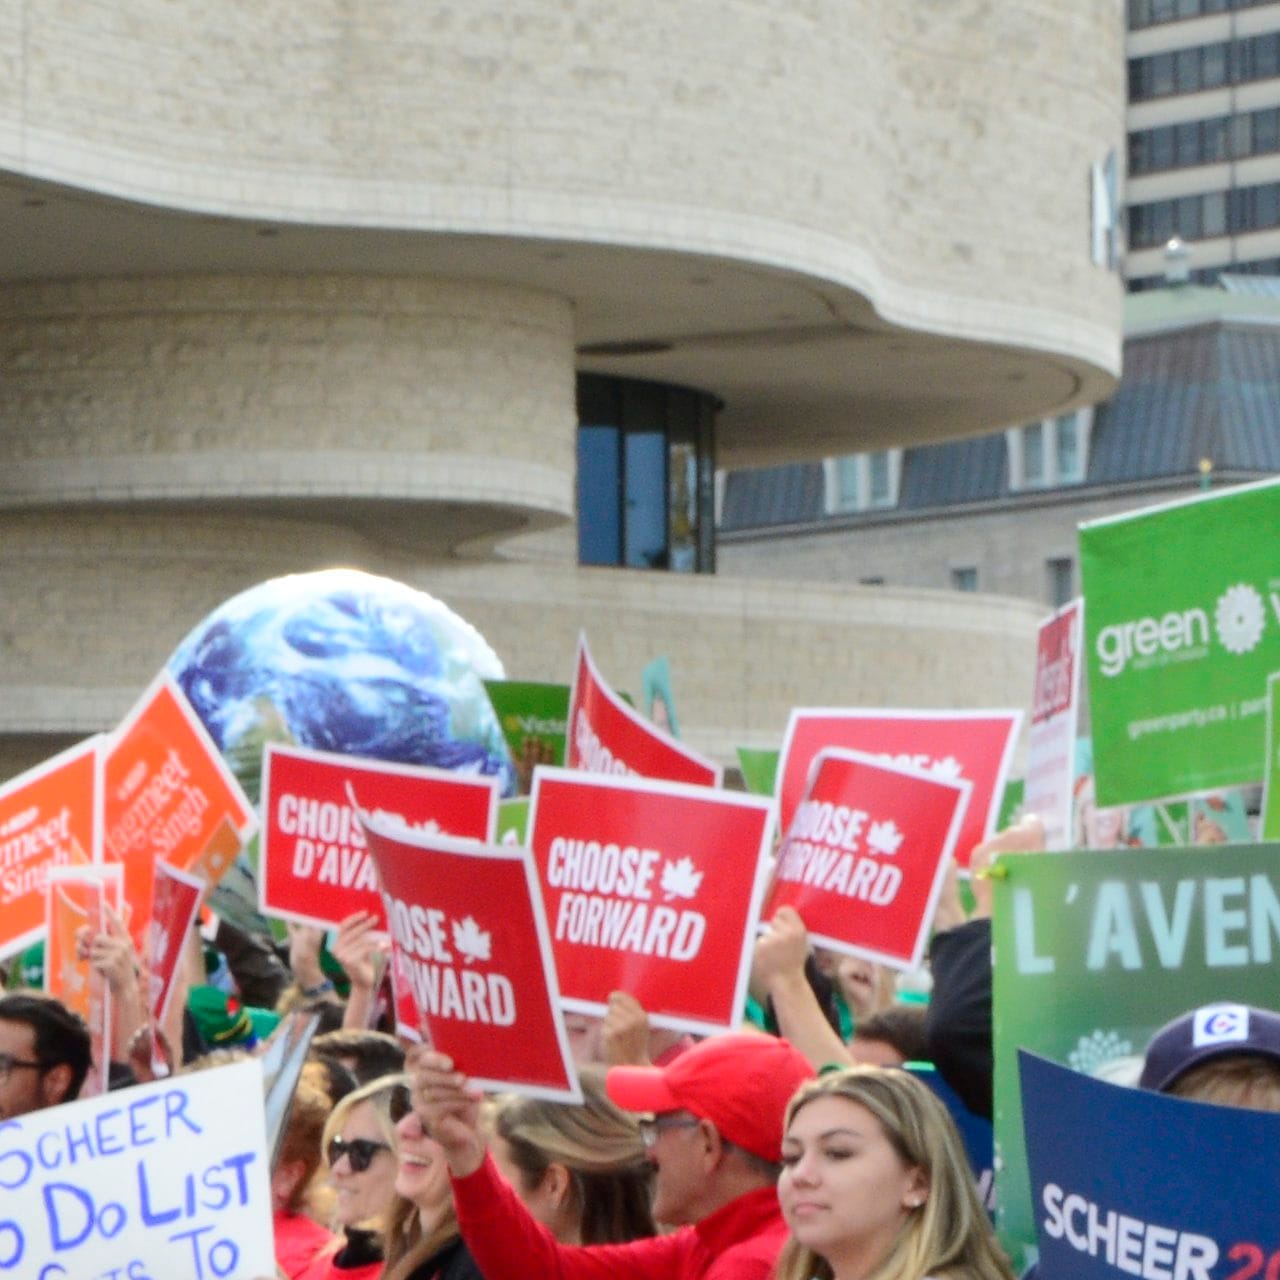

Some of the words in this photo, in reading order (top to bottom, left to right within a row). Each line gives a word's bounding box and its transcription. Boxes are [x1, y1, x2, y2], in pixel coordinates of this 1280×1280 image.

[1096, 607, 1211, 678] green
[547, 836, 662, 899] CHOOSE
[555, 893, 707, 962] FORWARD
